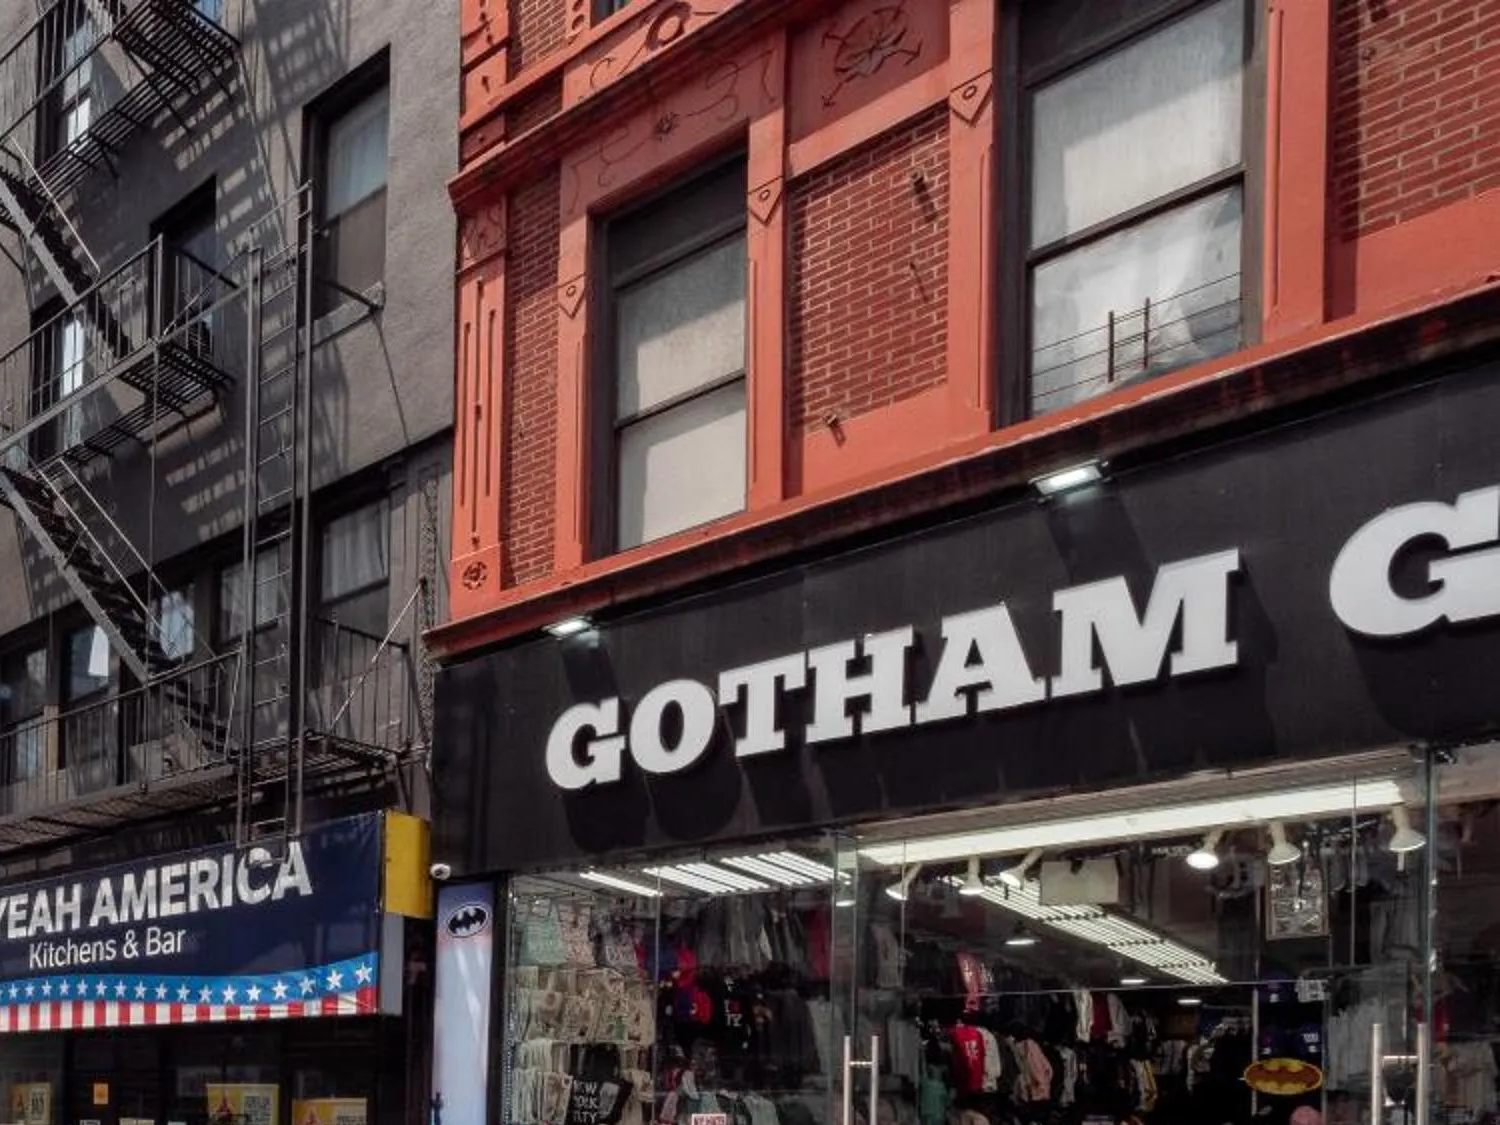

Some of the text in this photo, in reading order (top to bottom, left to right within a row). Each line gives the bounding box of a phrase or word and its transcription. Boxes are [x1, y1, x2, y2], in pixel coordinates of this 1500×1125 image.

[544, 548, 1240, 791] GOTHAM
[89, 841, 314, 927] AMERICA
[29, 926, 187, 970] Kitchens & Bar
